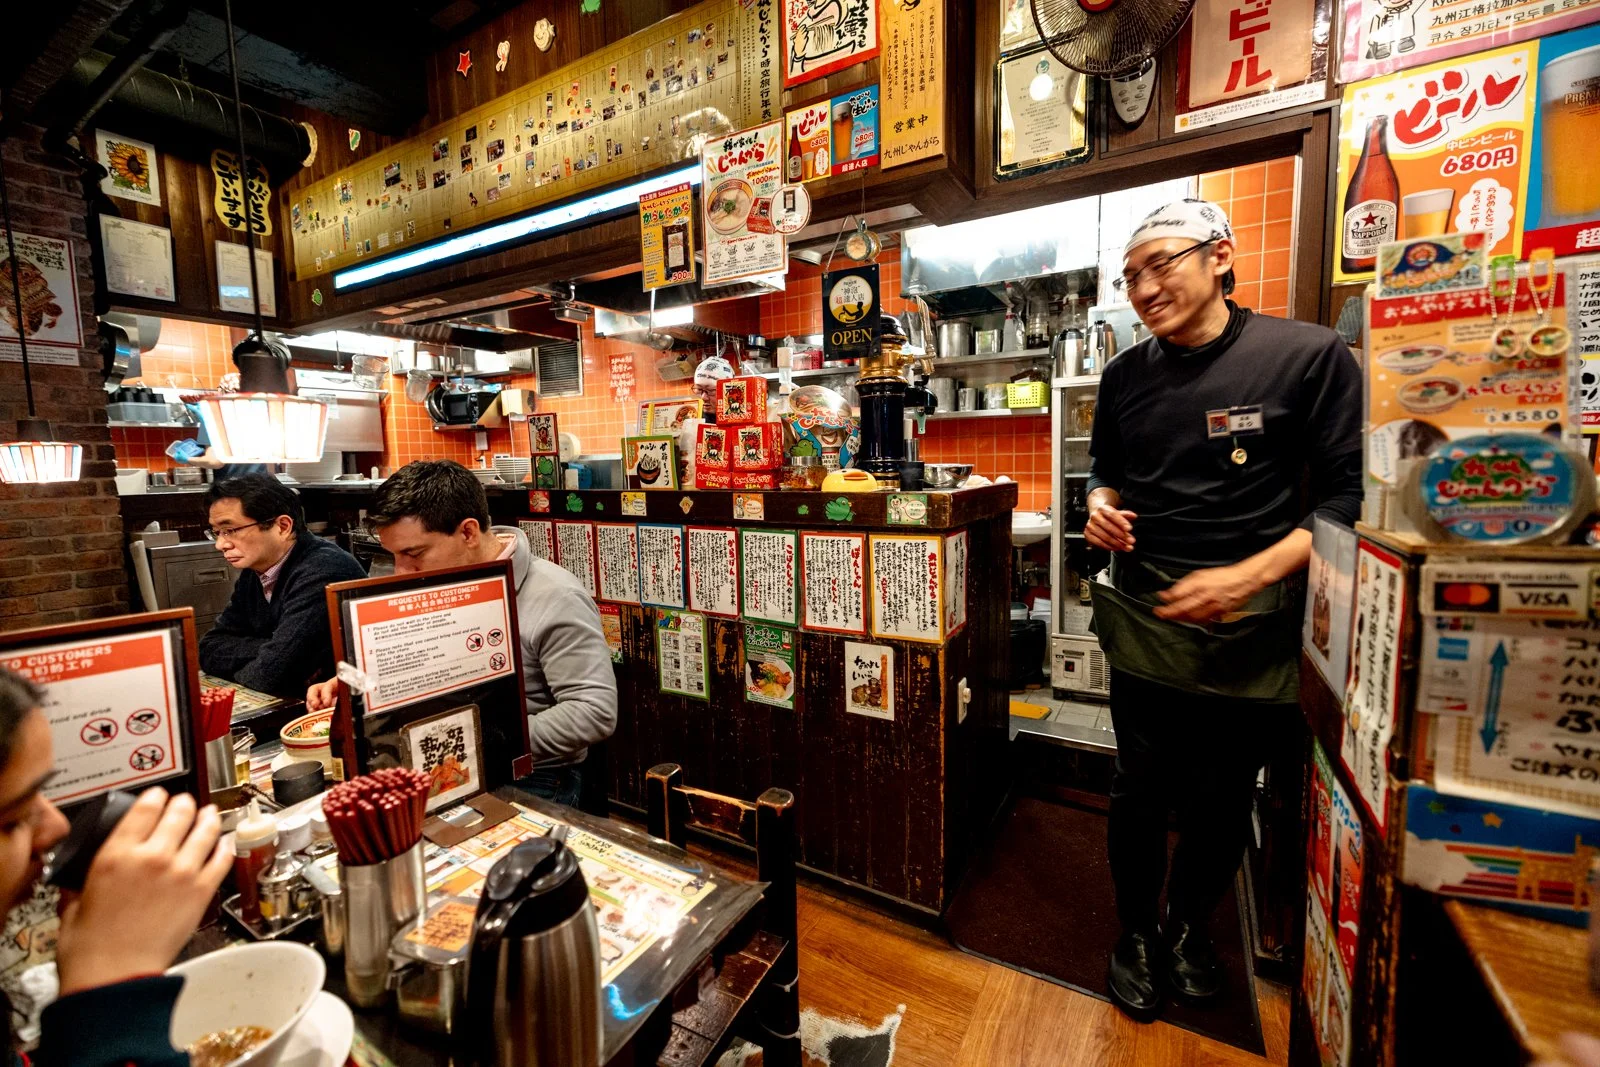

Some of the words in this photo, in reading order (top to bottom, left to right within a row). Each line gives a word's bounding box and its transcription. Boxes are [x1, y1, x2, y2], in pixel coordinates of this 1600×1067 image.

[1394, 70, 1522, 145] ビール
[893, 113, 929, 135] 営業中
[883, 135, 940, 161] 九州じゃんがら
[1446, 130, 1516, 151] 中ビンビール
[717, 142, 765, 174] じゃんがら
[1443, 147, 1514, 175] 680円
[1353, 228, 1387, 238] SAPPORO
[831, 328, 873, 346] OPEN
[1502, 410, 1560, 421] ¥580
[388, 592, 427, 607] REQUESTS
[428, 591, 438, 600] TO
[440, 584, 480, 597] CUSTOMERS
[1516, 592, 1569, 606] VISA
[26, 645, 113, 668] CUSTOMERS
[72, 712, 88, 720] and
[90, 706, 112, 716] drink
